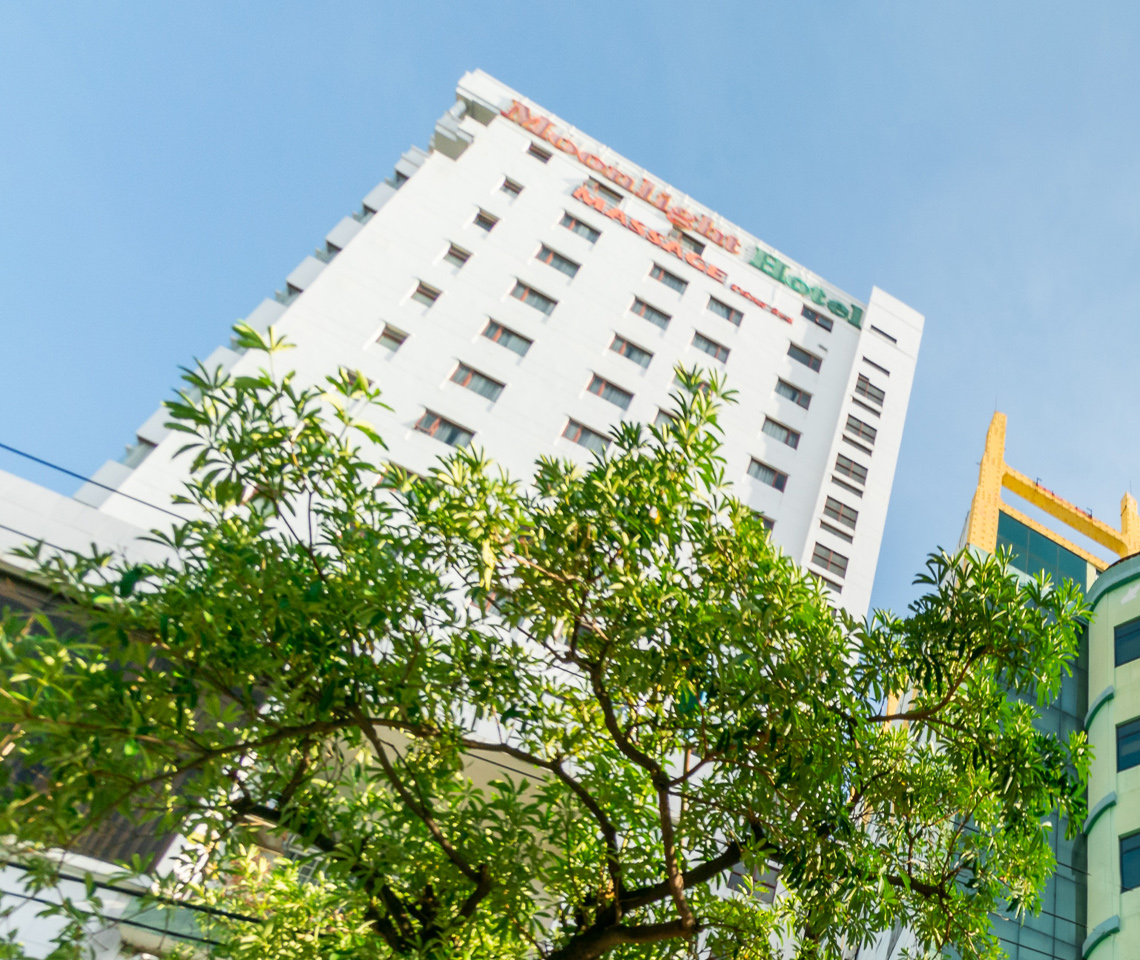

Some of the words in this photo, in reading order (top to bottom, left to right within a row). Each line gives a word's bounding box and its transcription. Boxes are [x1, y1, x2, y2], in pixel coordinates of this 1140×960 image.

[499, 99, 741, 255] Moonlight
[748, 246, 864, 330] Hotel
[571, 186, 728, 285] MASSAGE
